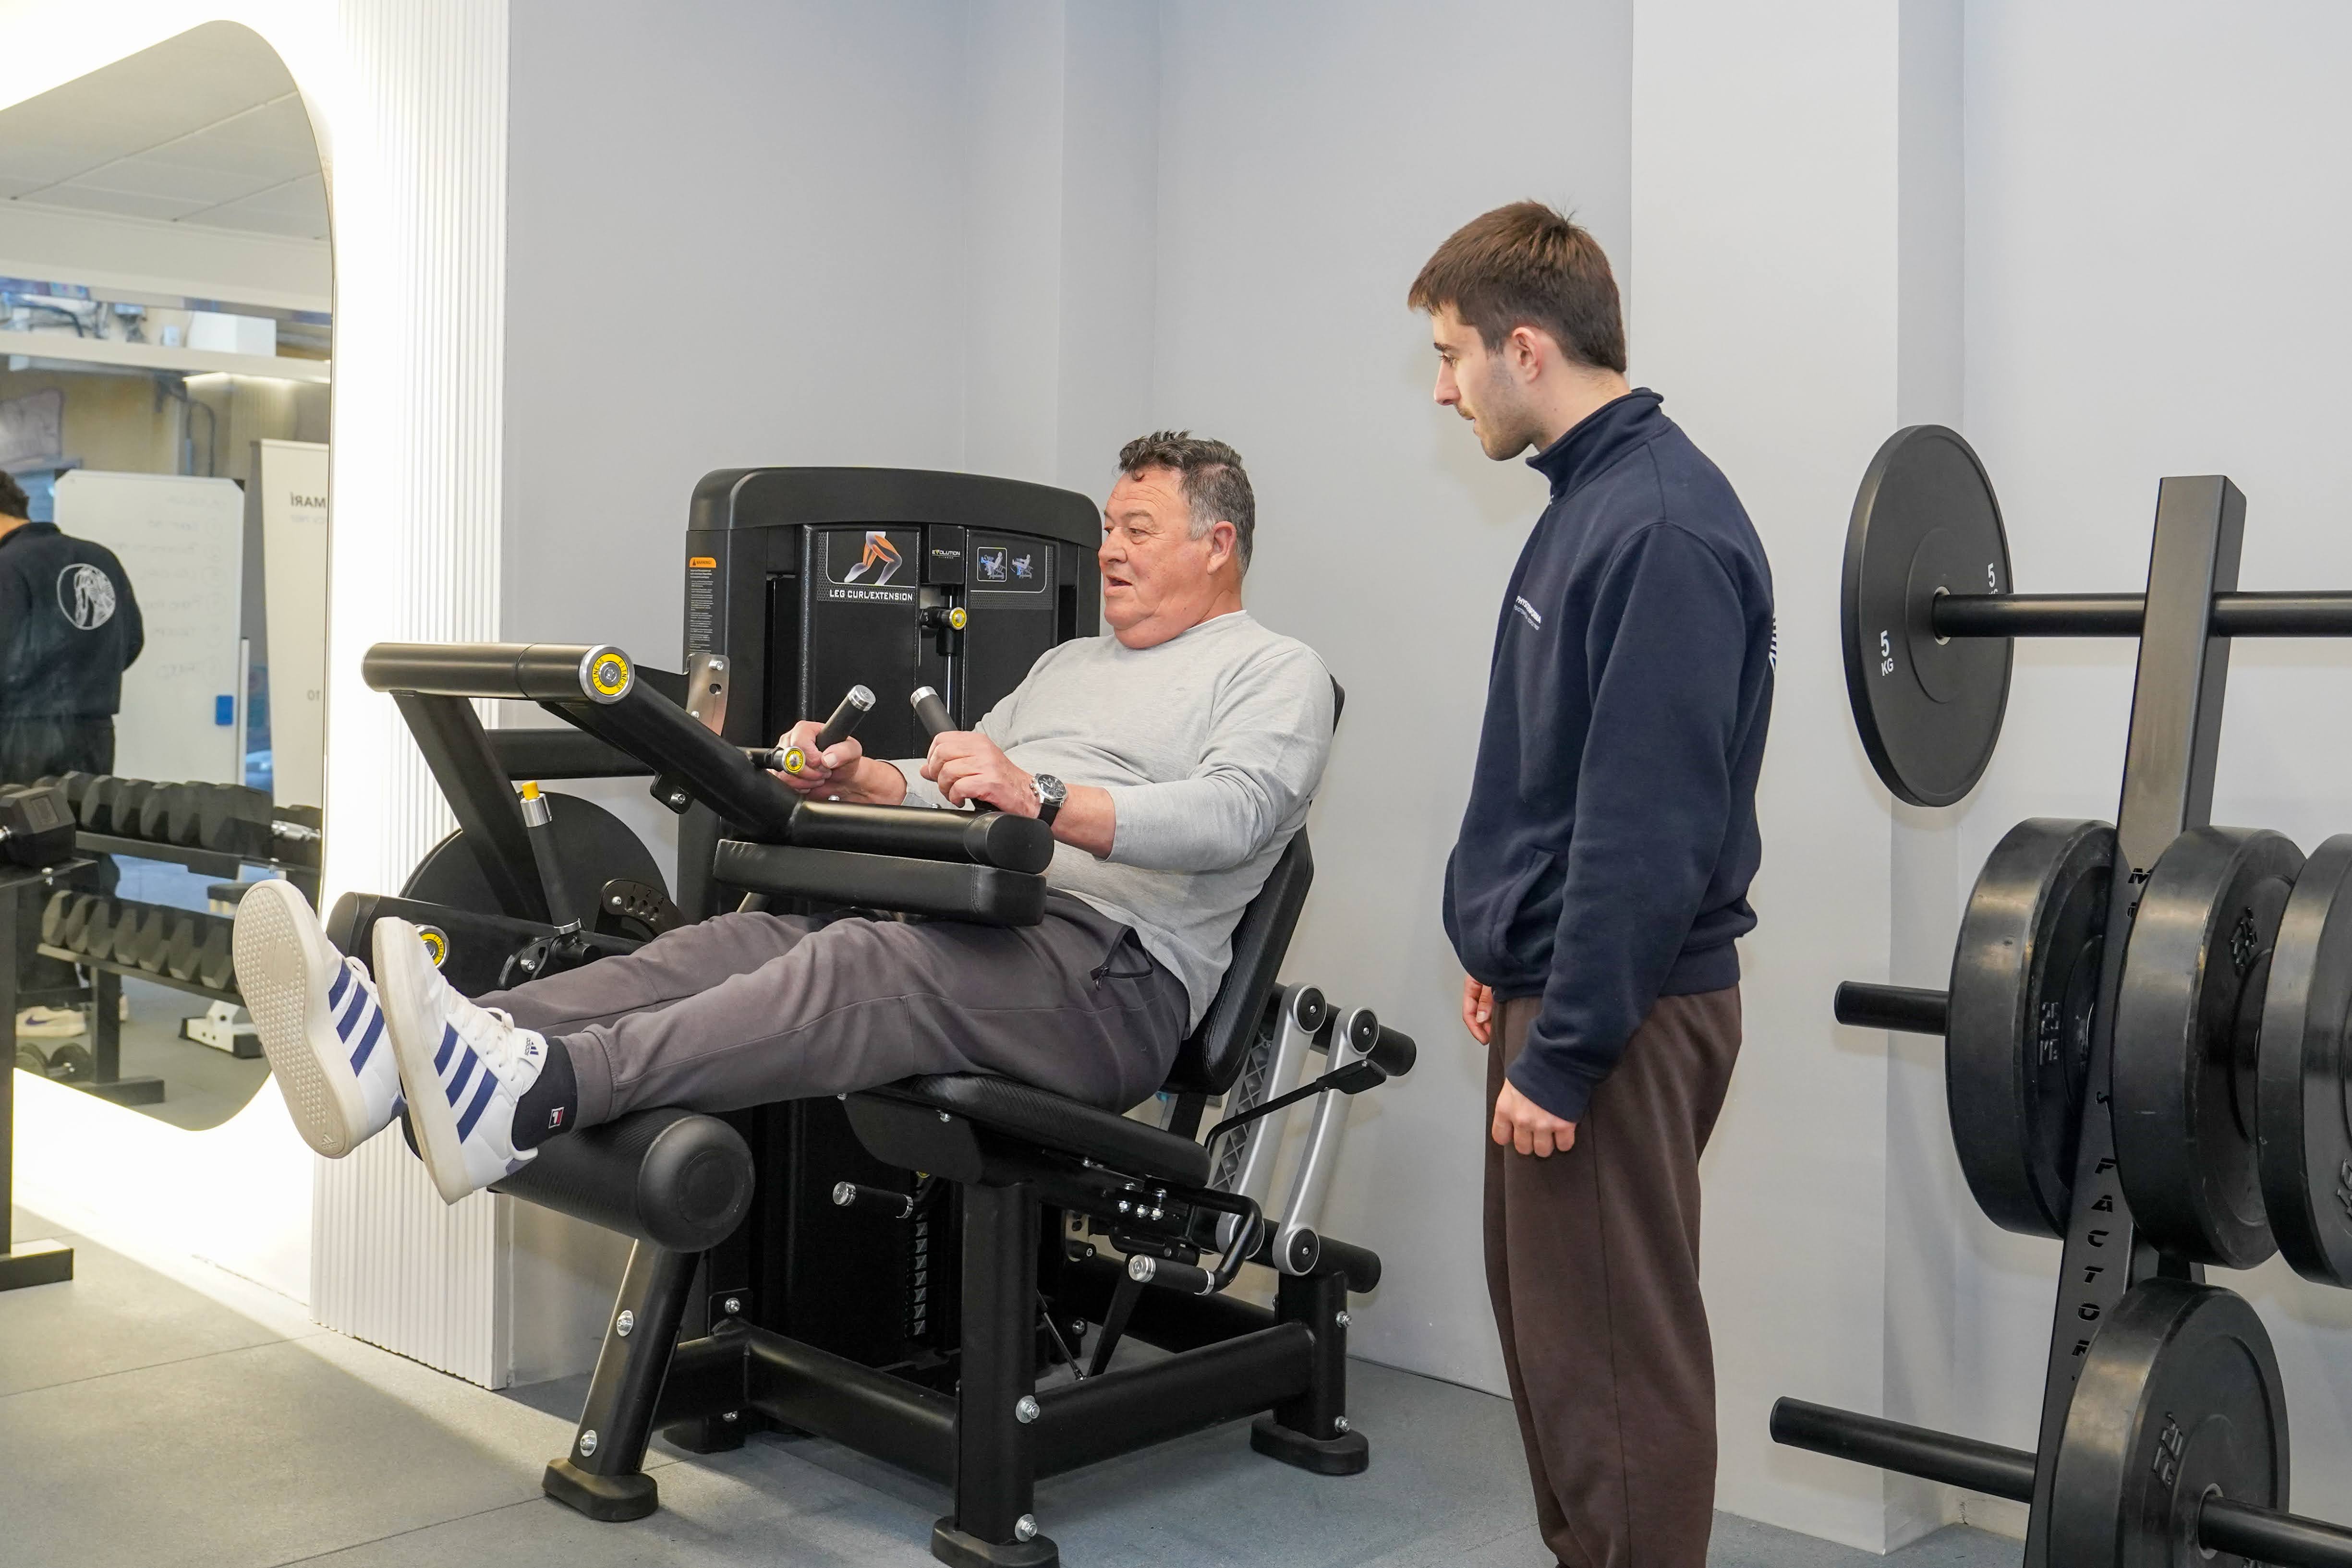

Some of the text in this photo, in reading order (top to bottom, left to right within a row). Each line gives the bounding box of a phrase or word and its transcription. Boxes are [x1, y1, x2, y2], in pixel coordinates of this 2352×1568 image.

[1988, 563, 1995, 588] 5
[829, 589, 913, 601] LEG CURL/EXTENSION
[1880, 630, 1890, 657] 5
[593, 658, 605, 688] FITNESS
[616, 660, 627, 690] FITNESS
[1881, 658, 1894, 676] KG
[646, 889, 651, 898] 2
[434, 936, 443, 958] FITNESS
[2071, 1157, 2117, 1381] FACTOR
